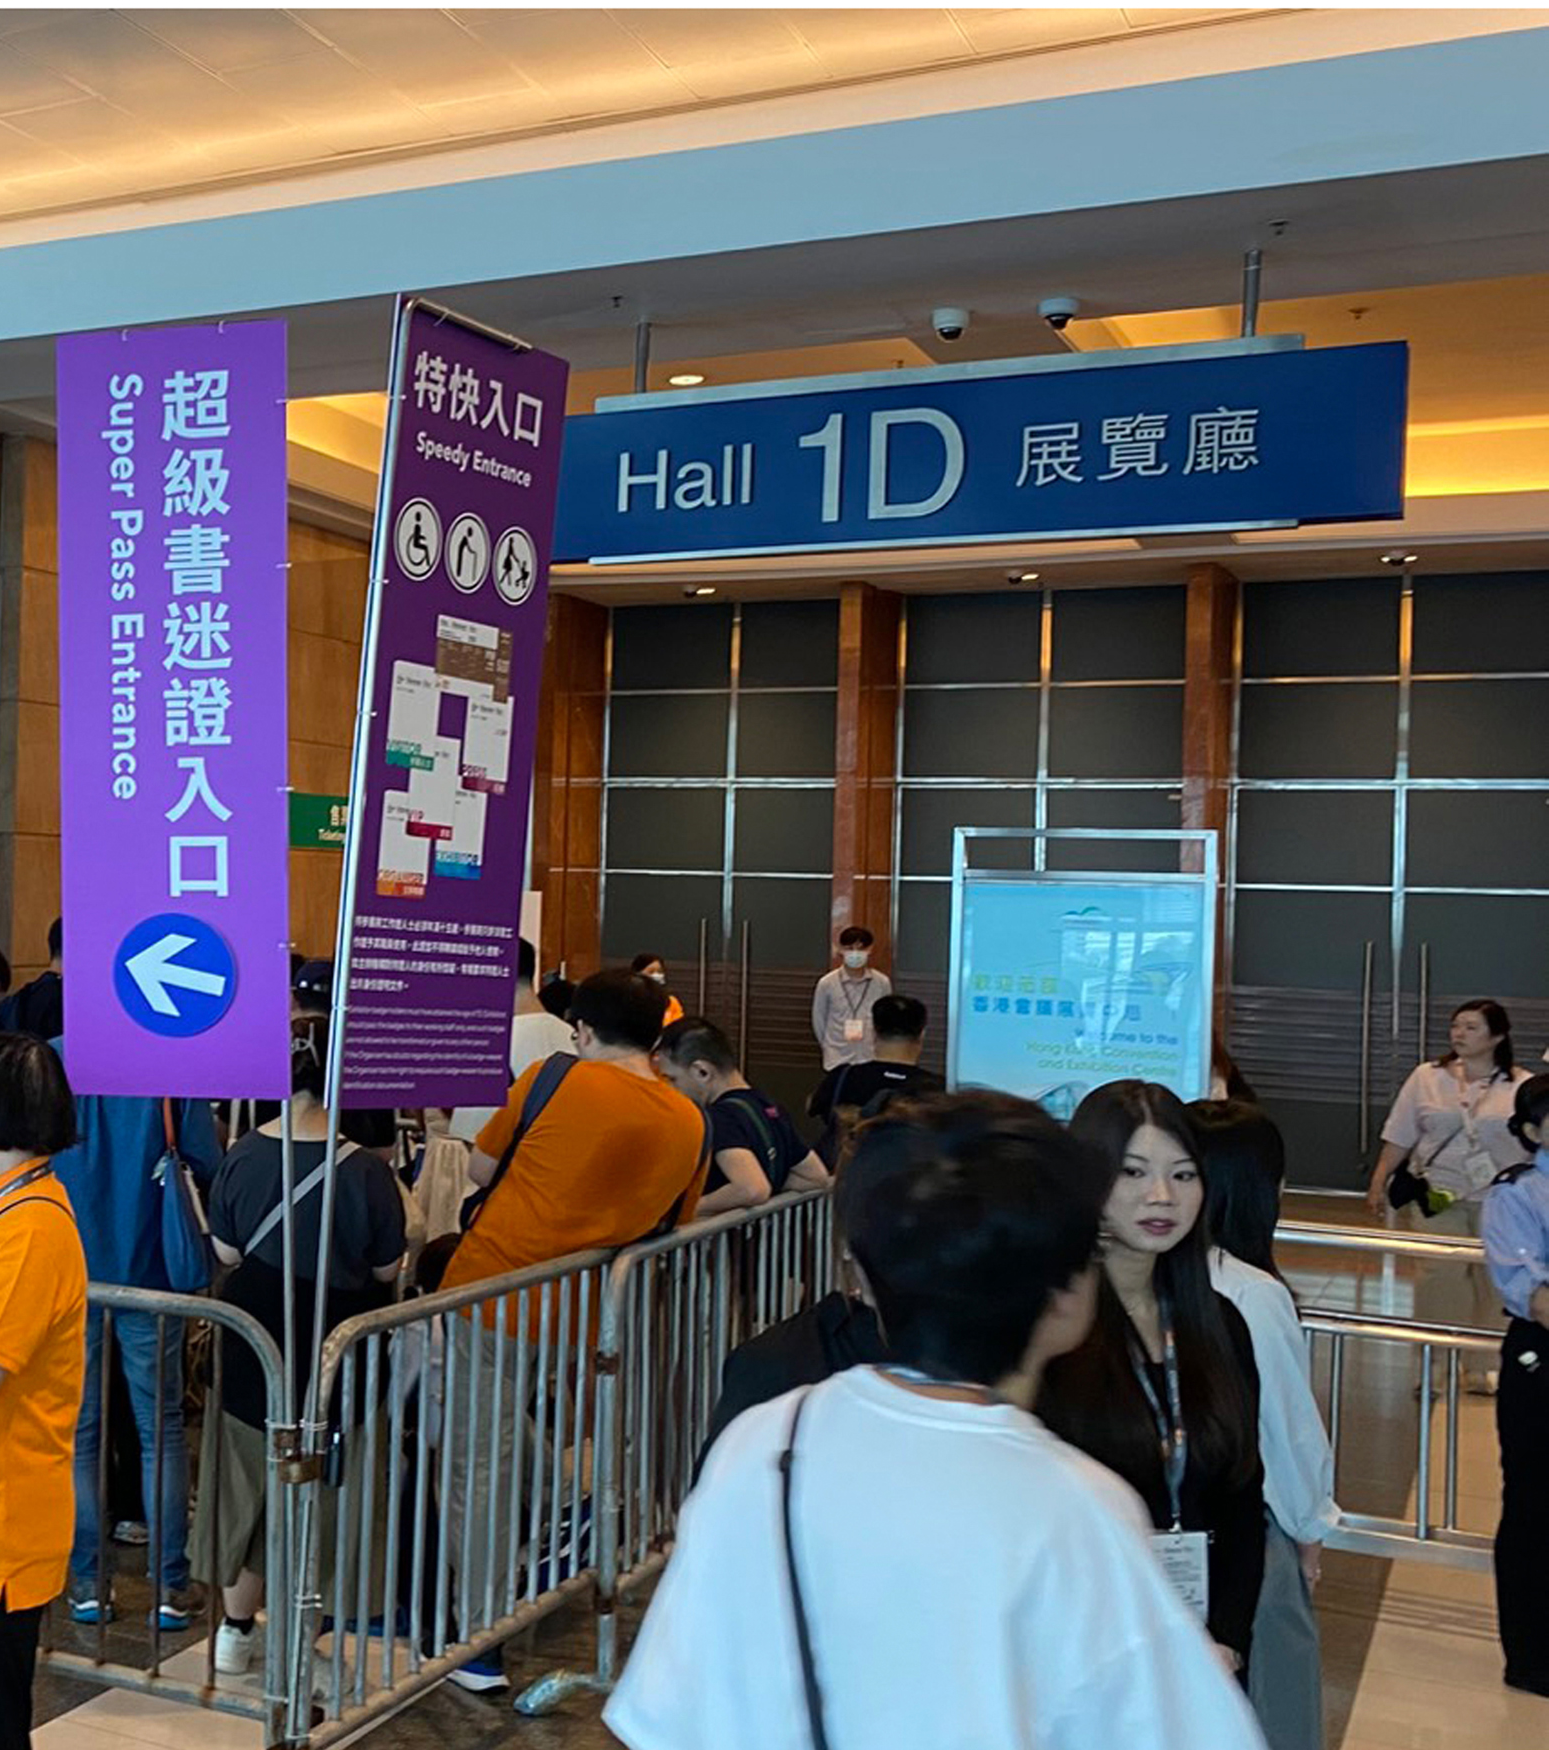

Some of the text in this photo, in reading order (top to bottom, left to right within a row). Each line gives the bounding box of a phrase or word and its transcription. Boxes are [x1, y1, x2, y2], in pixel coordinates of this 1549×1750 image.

[413, 350, 544, 448] 特快入口
[1014, 406, 1261, 488] 展覽廳
[416, 430, 533, 488] Speedy Entrance
[616, 406, 965, 523] Hall 1D
[101, 372, 144, 802] Super Pass Entrance
[160, 368, 233, 899] 超級書迷證入口
[1139, 1030, 1154, 1044] to
[1155, 1032, 1179, 1046] the
